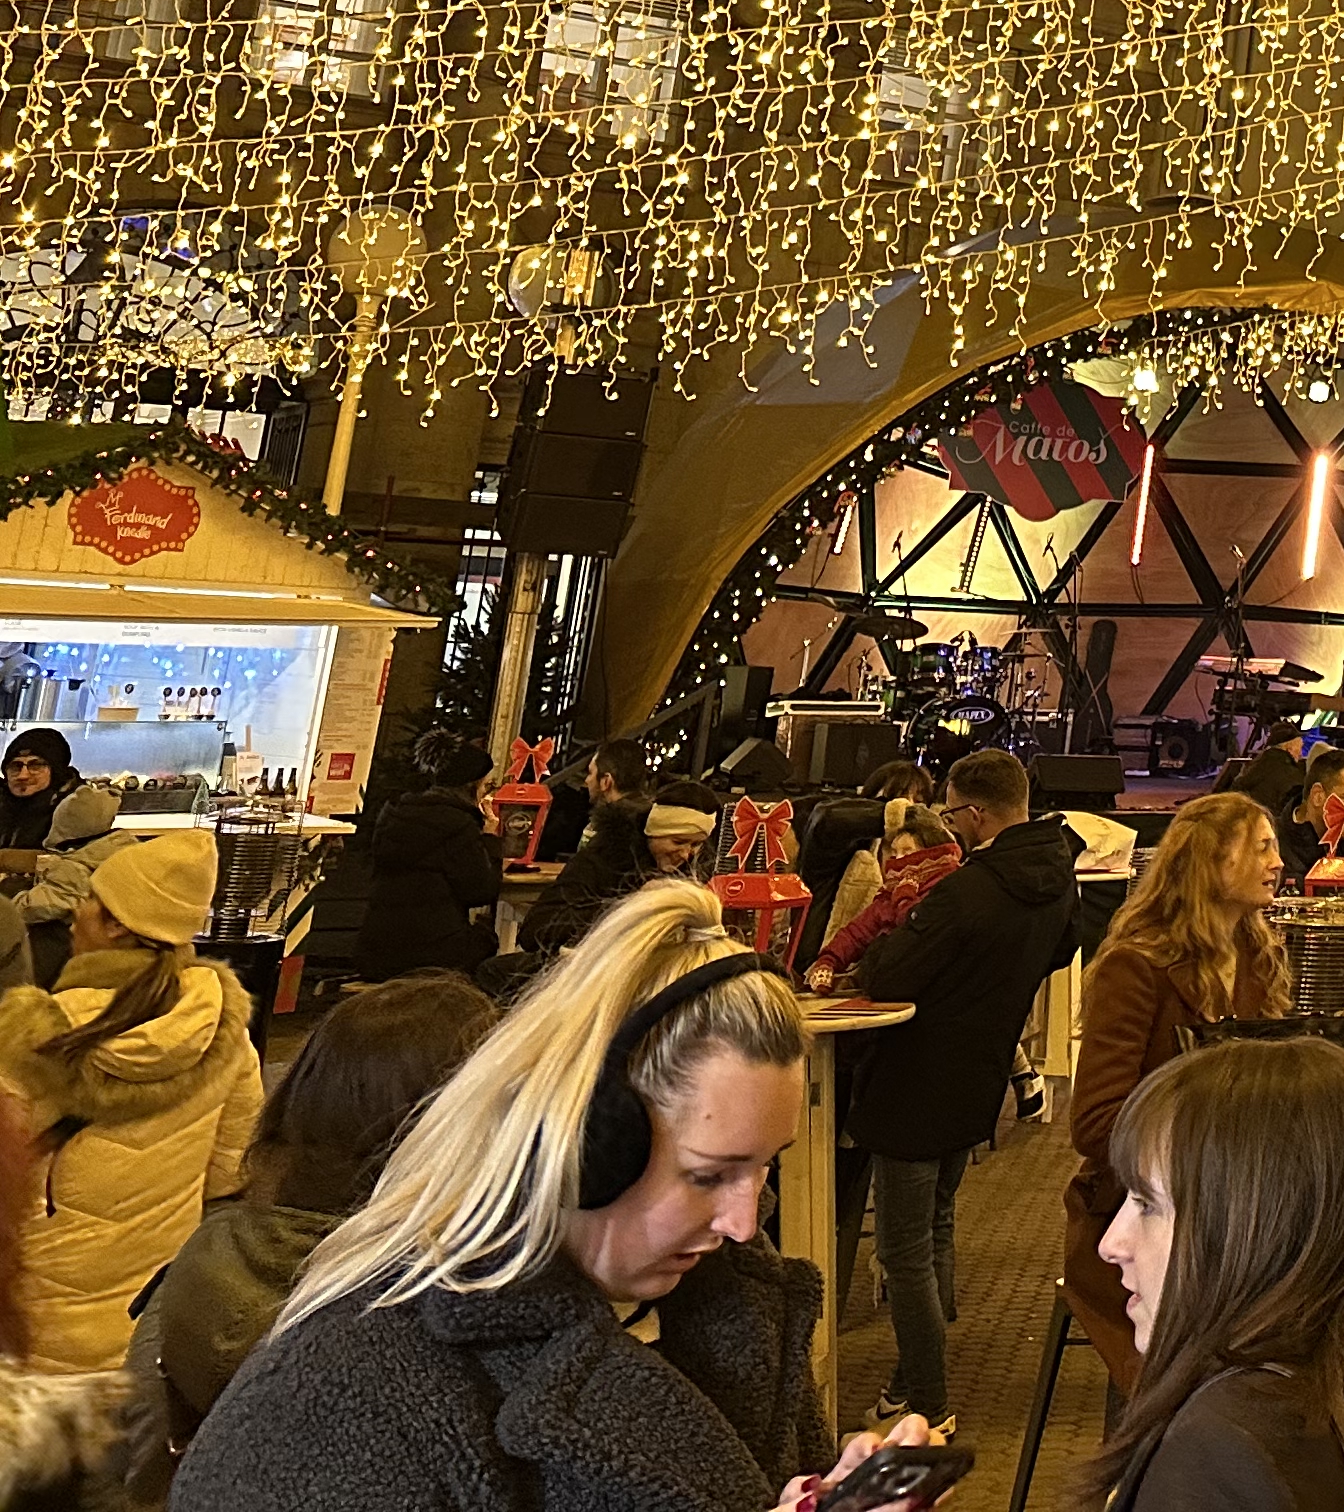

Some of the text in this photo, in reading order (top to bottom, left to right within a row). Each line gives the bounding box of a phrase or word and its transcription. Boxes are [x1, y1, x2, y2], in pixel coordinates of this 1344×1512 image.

[1009, 420, 1076, 438] Caffe de
[104, 504, 174, 530] Ferdinand
